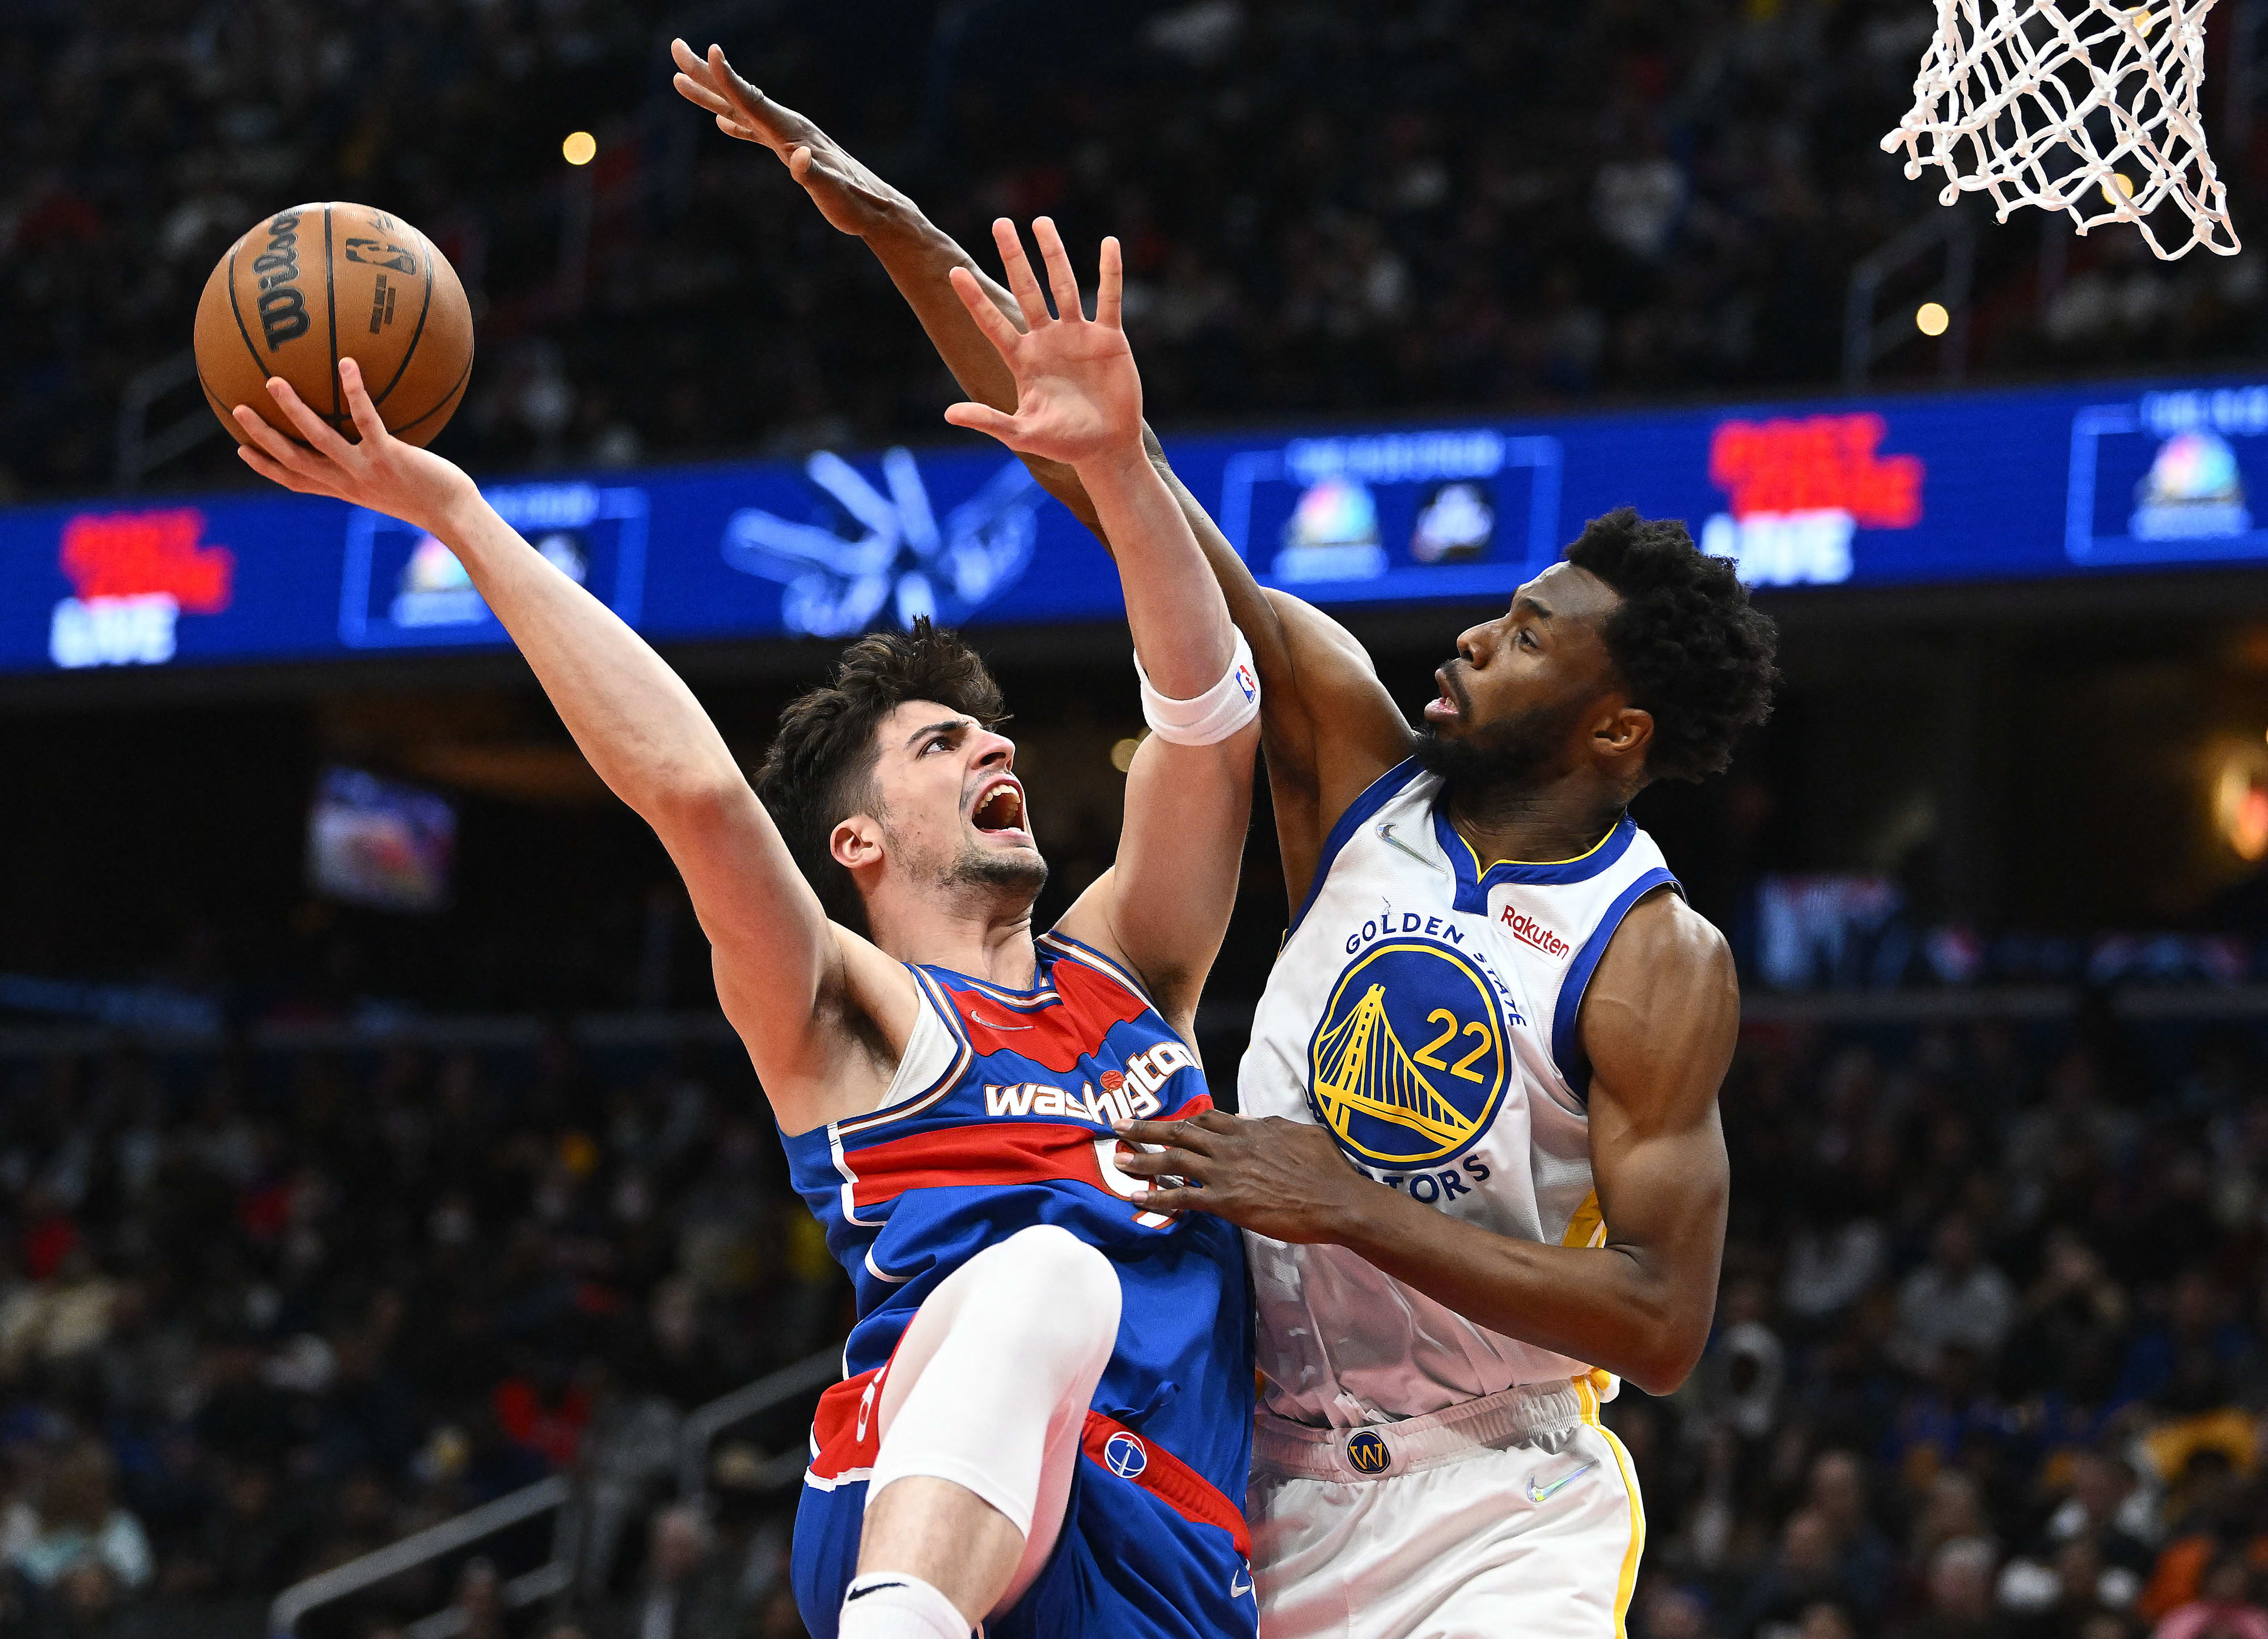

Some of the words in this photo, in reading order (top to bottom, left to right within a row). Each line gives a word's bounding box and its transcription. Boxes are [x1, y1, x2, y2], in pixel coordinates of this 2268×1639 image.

[1346, 912, 1465, 955] GOLDEN
[1474, 952, 1527, 1027] STATE
[1501, 905, 1569, 960] Rakuten
[1413, 1008, 1492, 1084] 22
